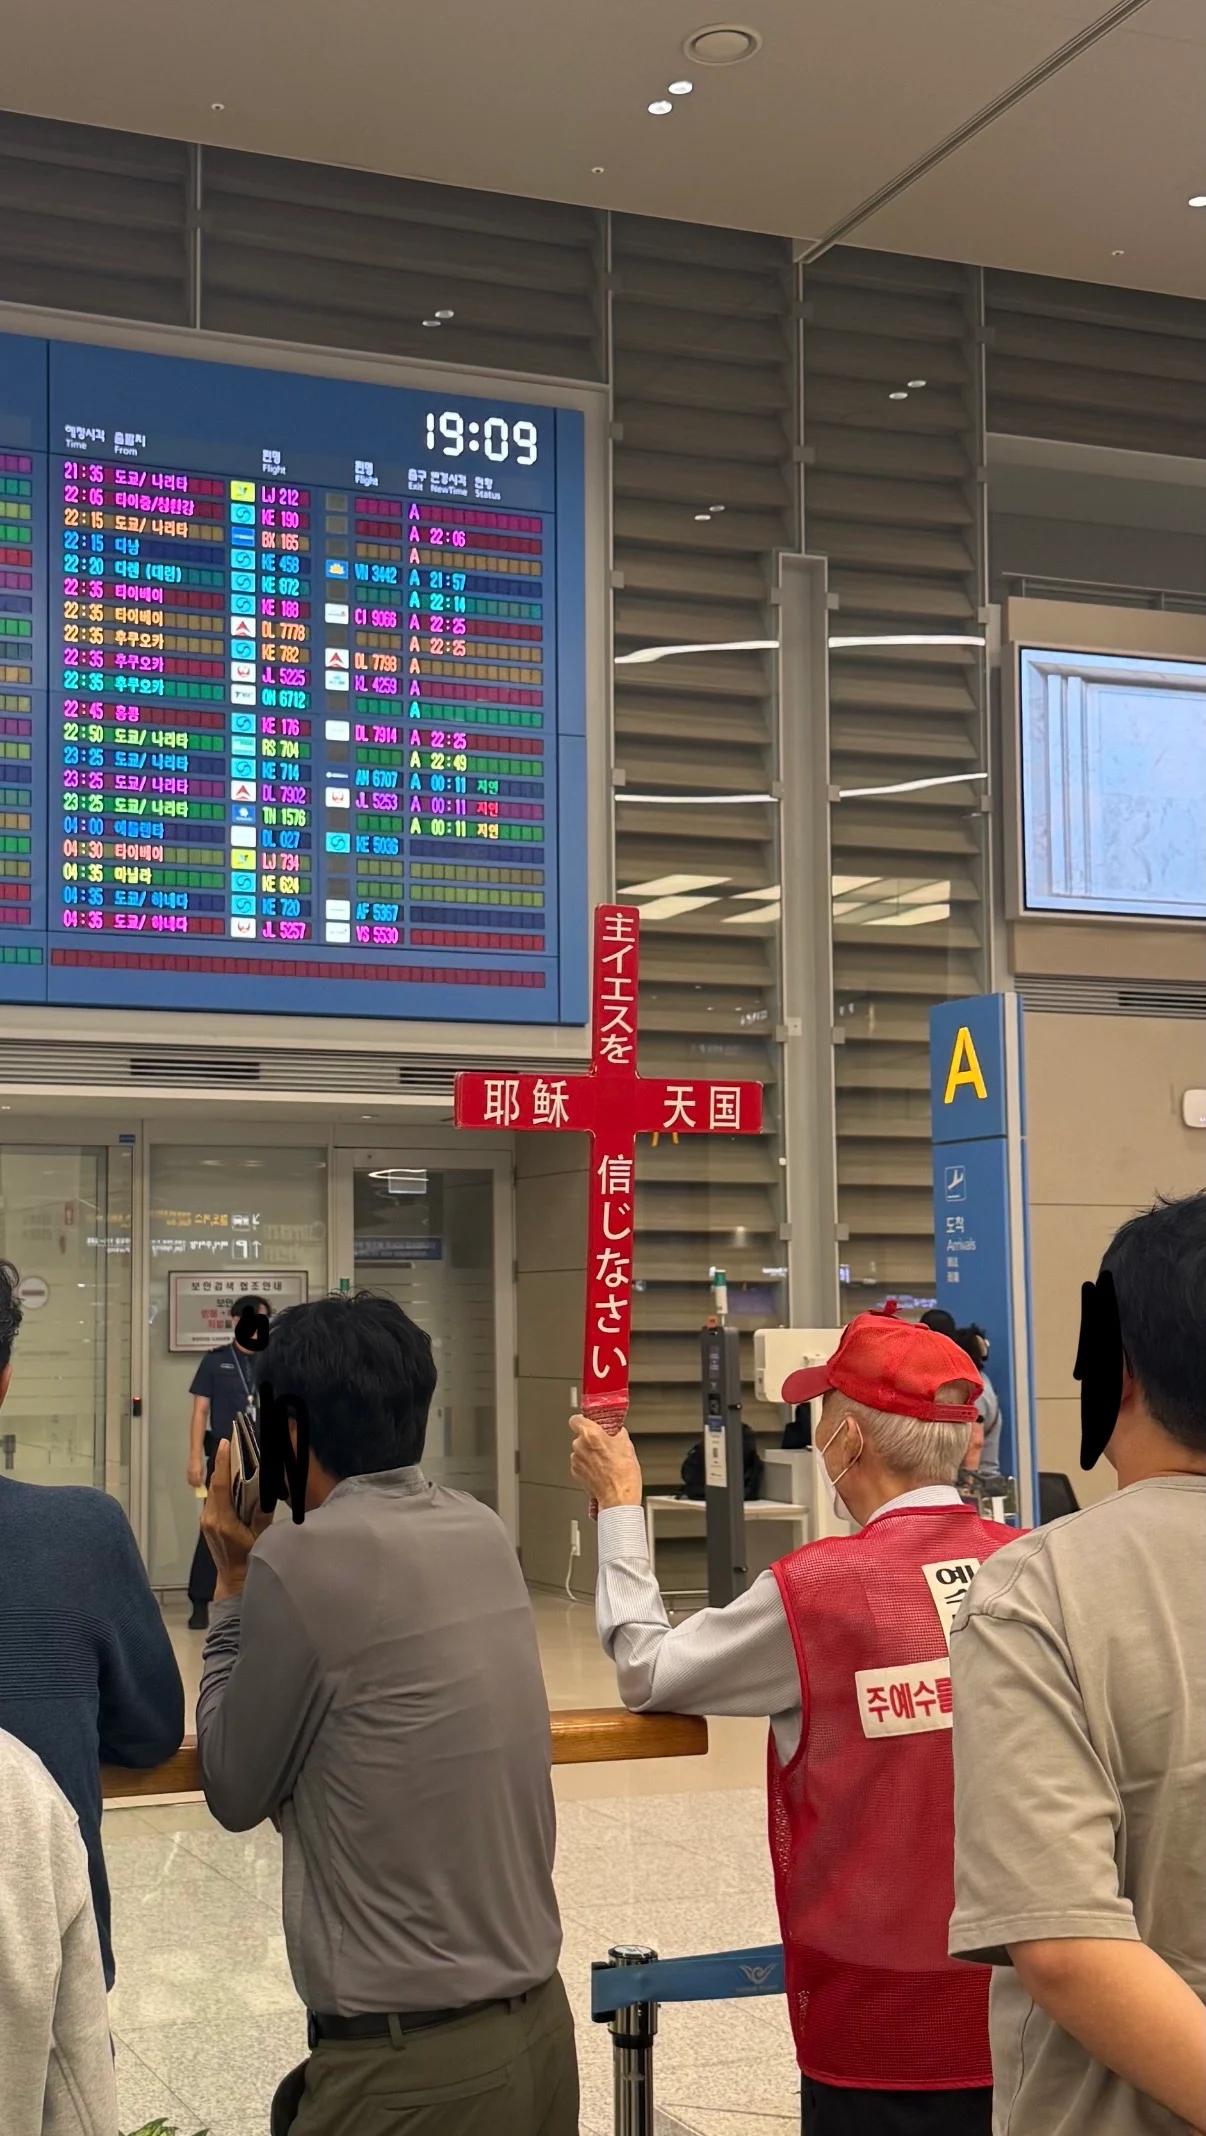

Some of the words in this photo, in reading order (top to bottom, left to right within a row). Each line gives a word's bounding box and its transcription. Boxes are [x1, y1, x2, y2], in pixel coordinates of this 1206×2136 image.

[65, 439, 87, 450] Time
[426, 411, 538, 466] 19:09
[114, 445, 138, 456] From
[262, 463, 286, 476] Flight
[151, 473, 187, 492] 나리타
[355, 474, 379, 487] Flight
[408, 481, 423, 491] Exit
[261, 486, 275, 503] LJ
[279, 487, 298, 506] 212
[475, 489, 501, 500] Status
[261, 508, 274, 525] KE
[409, 503, 419, 519] A
[152, 519, 187, 537] 나리타
[409, 526, 419, 541] A
[261, 531, 275, 547] BX
[281, 533, 298, 550] 165
[261, 553, 275, 571] KE
[409, 548, 419, 563] A
[261, 575, 275, 593] KE
[409, 569, 419, 585] A
[115, 584, 162, 603] 타이베이
[409, 591, 419, 608] A
[261, 598, 274, 615] KE
[115, 607, 162, 626] 타이베이
[354, 608, 366, 624] CI
[409, 613, 419, 629] A
[114, 630, 163, 649] 후쿠오카
[261, 620, 275, 638] DL
[279, 622, 305, 641] 7778
[261, 643, 275, 660] KE
[279, 645, 299, 662] 782
[409, 636, 419, 651] A
[115, 653, 163, 672] 후쿠오카
[354, 652, 367, 669] DL
[409, 658, 420, 673] A
[262, 666, 275, 683] JL
[114, 675, 164, 695] 후쿠오카
[354, 675, 368, 691] KL
[372, 676, 396, 694] 4259
[409, 679, 420, 695] A
[279, 690, 305, 708] 6712
[115, 704, 139, 721] 홍콩
[409, 701, 420, 718] A
[262, 716, 275, 733] KE
[281, 718, 299, 735] 176
[355, 724, 368, 741] DL
[372, 725, 396, 742] 7914
[151, 730, 188, 748] 나리타
[410, 729, 420, 745] A
[262, 738, 276, 756] RS
[279, 740, 299, 758] 704
[151, 753, 188, 771] 나리타
[410, 750, 420, 767] A
[262, 761, 275, 779] KE
[279, 762, 299, 780] 714
[372, 769, 397, 787] 6707
[152, 776, 188, 794] 나리타
[410, 773, 421, 789] A
[262, 784, 275, 801] DL
[280, 785, 305, 804] 7902
[355, 791, 368, 808] JL
[410, 795, 420, 811] A
[151, 799, 188, 817] 나리타
[281, 808, 305, 826] 1576
[410, 817, 421, 833] A
[262, 829, 276, 847] DL
[279, 830, 299, 848] 027
[355, 835, 369, 852] KE
[115, 843, 162, 861] 타이베이
[262, 852, 276, 869] LJ
[280, 853, 299, 870] 734
[114, 866, 151, 884] 마닐라
[262, 875, 275, 892] KE
[279, 875, 299, 893] 624
[151, 891, 188, 909] 하네다
[262, 897, 275, 915] KE
[280, 898, 300, 916] 720
[356, 902, 369, 919] AF
[151, 915, 187, 931] 하네다
[262, 921, 275, 937] JL
[279, 921, 305, 939] 5257
[356, 925, 369, 942] VS
[600, 912, 636, 1065] 主イエスを
[943, 1026, 988, 1105] A
[483, 1078, 570, 1128] 耶稣
[663, 1085, 741, 1130] 天国
[946, 1216, 965, 1233] 도착
[592, 1153, 634, 1379] 信じなさい
